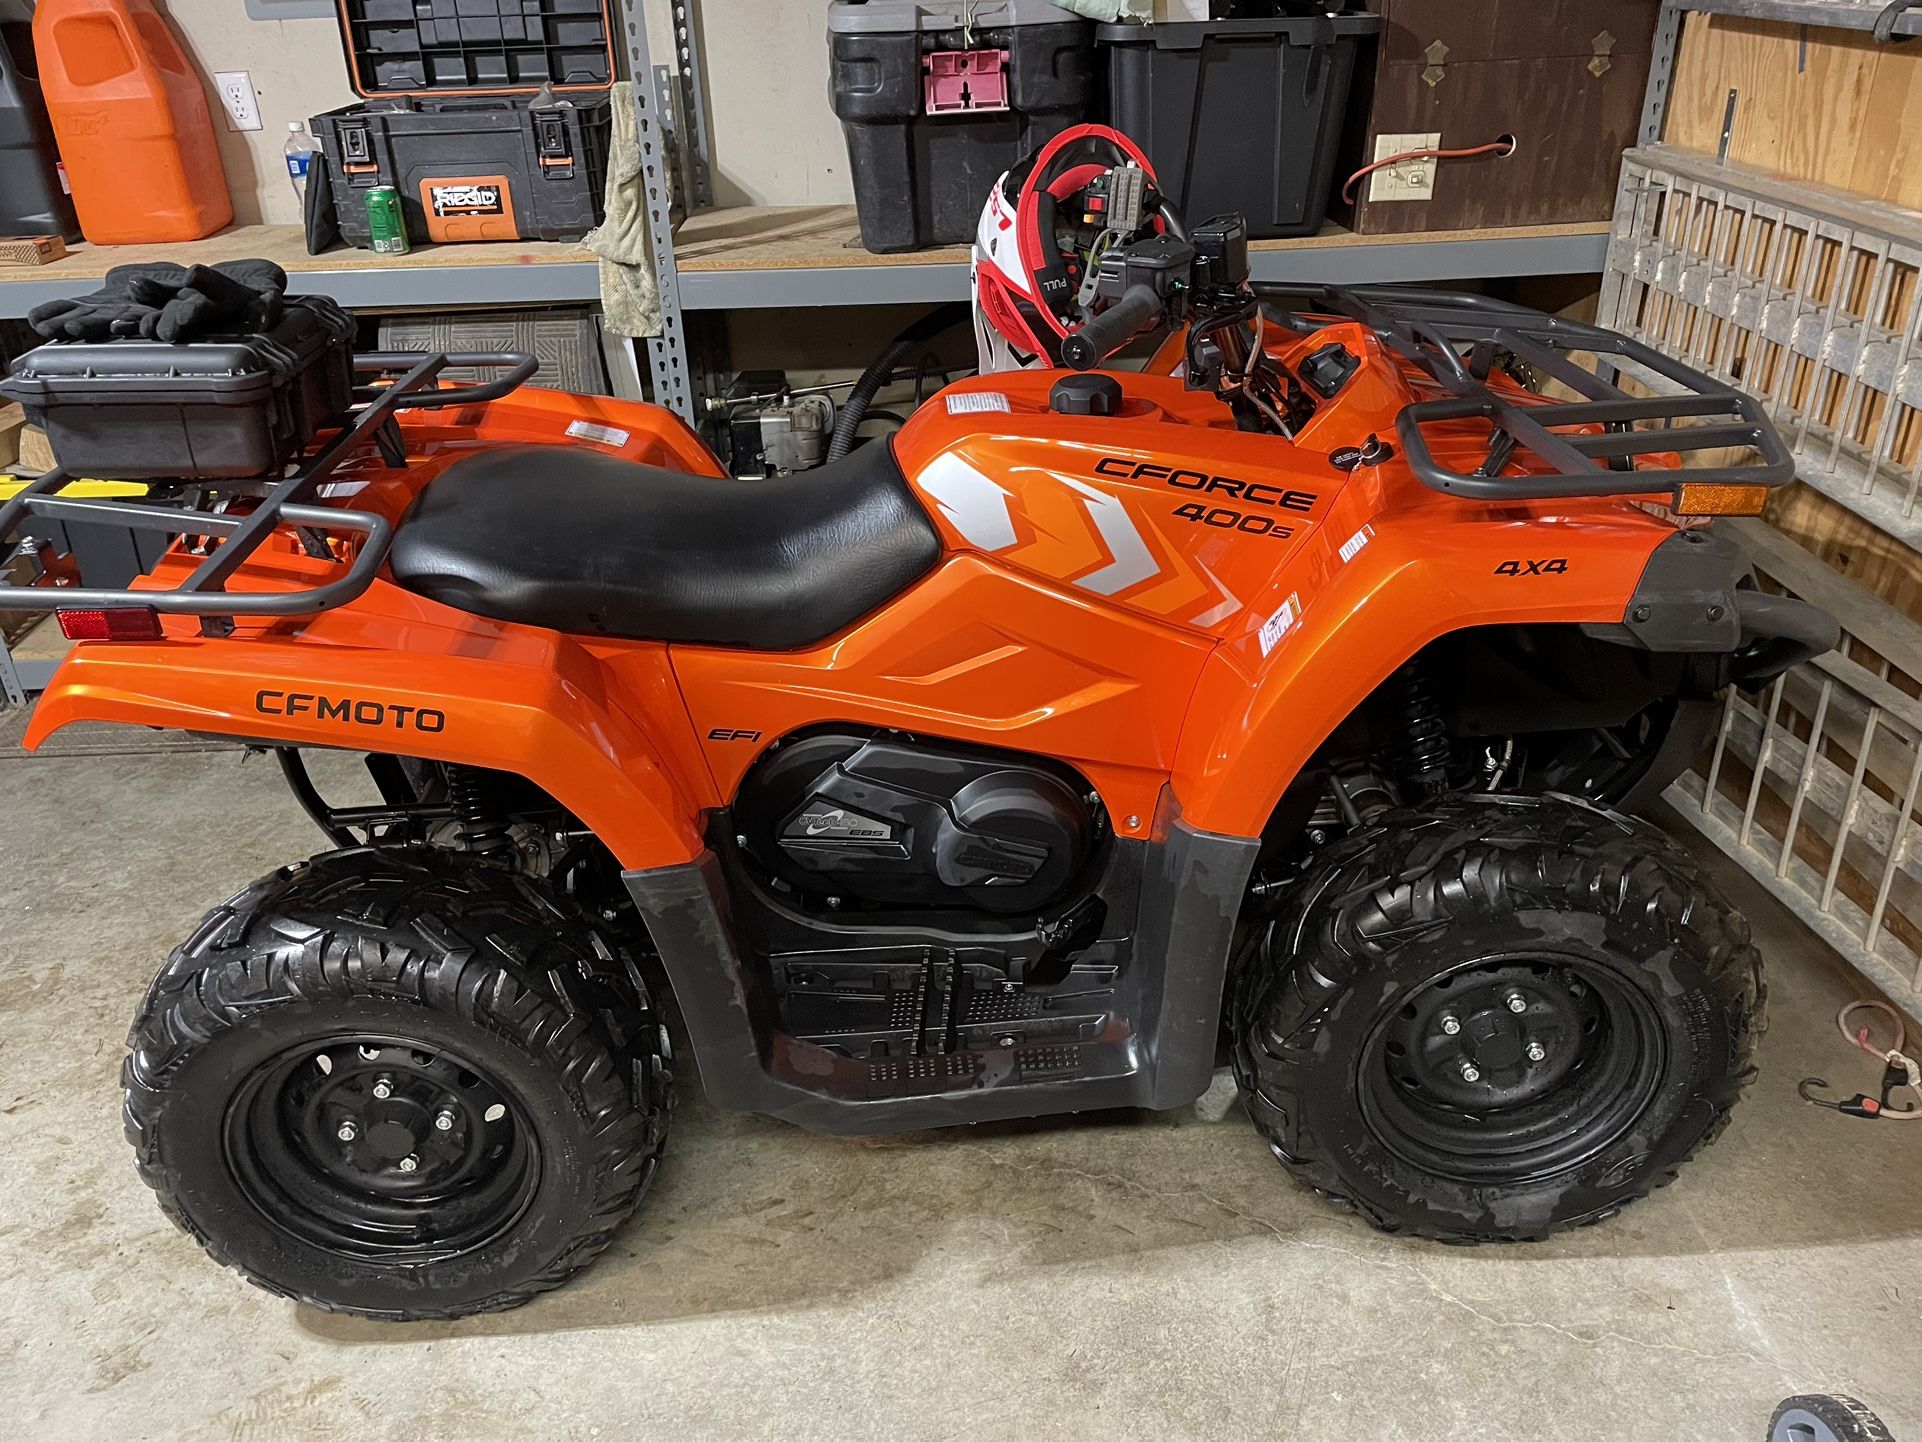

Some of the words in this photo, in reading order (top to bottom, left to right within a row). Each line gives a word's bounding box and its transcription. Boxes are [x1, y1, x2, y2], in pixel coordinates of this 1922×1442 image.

[1043, 277, 1067, 291] PULL
[1094, 457, 1318, 512] CFORCE
[255, 689, 445, 733] CFMOTO
[707, 728, 762, 743] EFI
